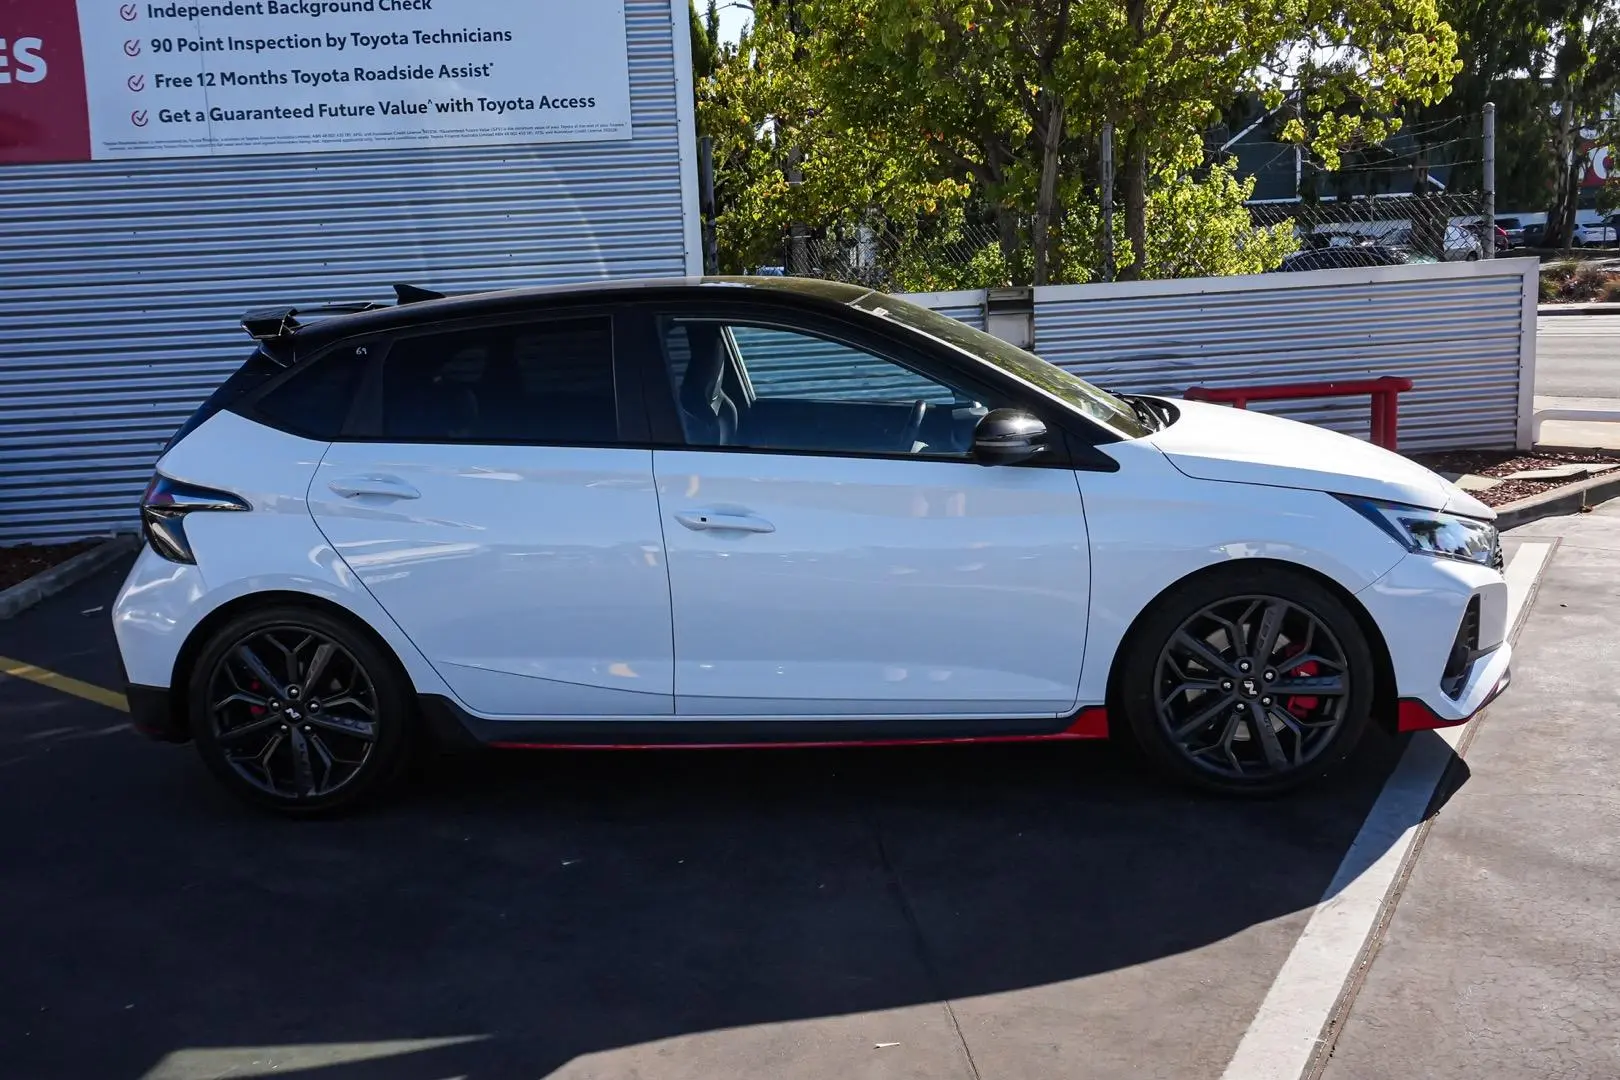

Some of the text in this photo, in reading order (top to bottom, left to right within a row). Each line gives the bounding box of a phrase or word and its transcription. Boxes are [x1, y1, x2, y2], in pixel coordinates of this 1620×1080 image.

[148, 0, 433, 21] Independent Background Check
[151, 28, 513, 54] 90 Point Inspection by Toyota Technicians
[155, 74, 193, 89] Free
[197, 72, 217, 87] 12
[220, 69, 288, 87] Months
[291, 68, 351, 88] Toyota
[354, 65, 434, 82] Roadside
[159, 109, 192, 123] Get
[196, 112, 206, 123] a
[210, 103, 315, 122] Guaranteed
[319, 104, 376, 118] Future
[435, 98, 474, 114] with
[477, 97, 535, 115] Toyota
[539, 96, 596, 110] Access
